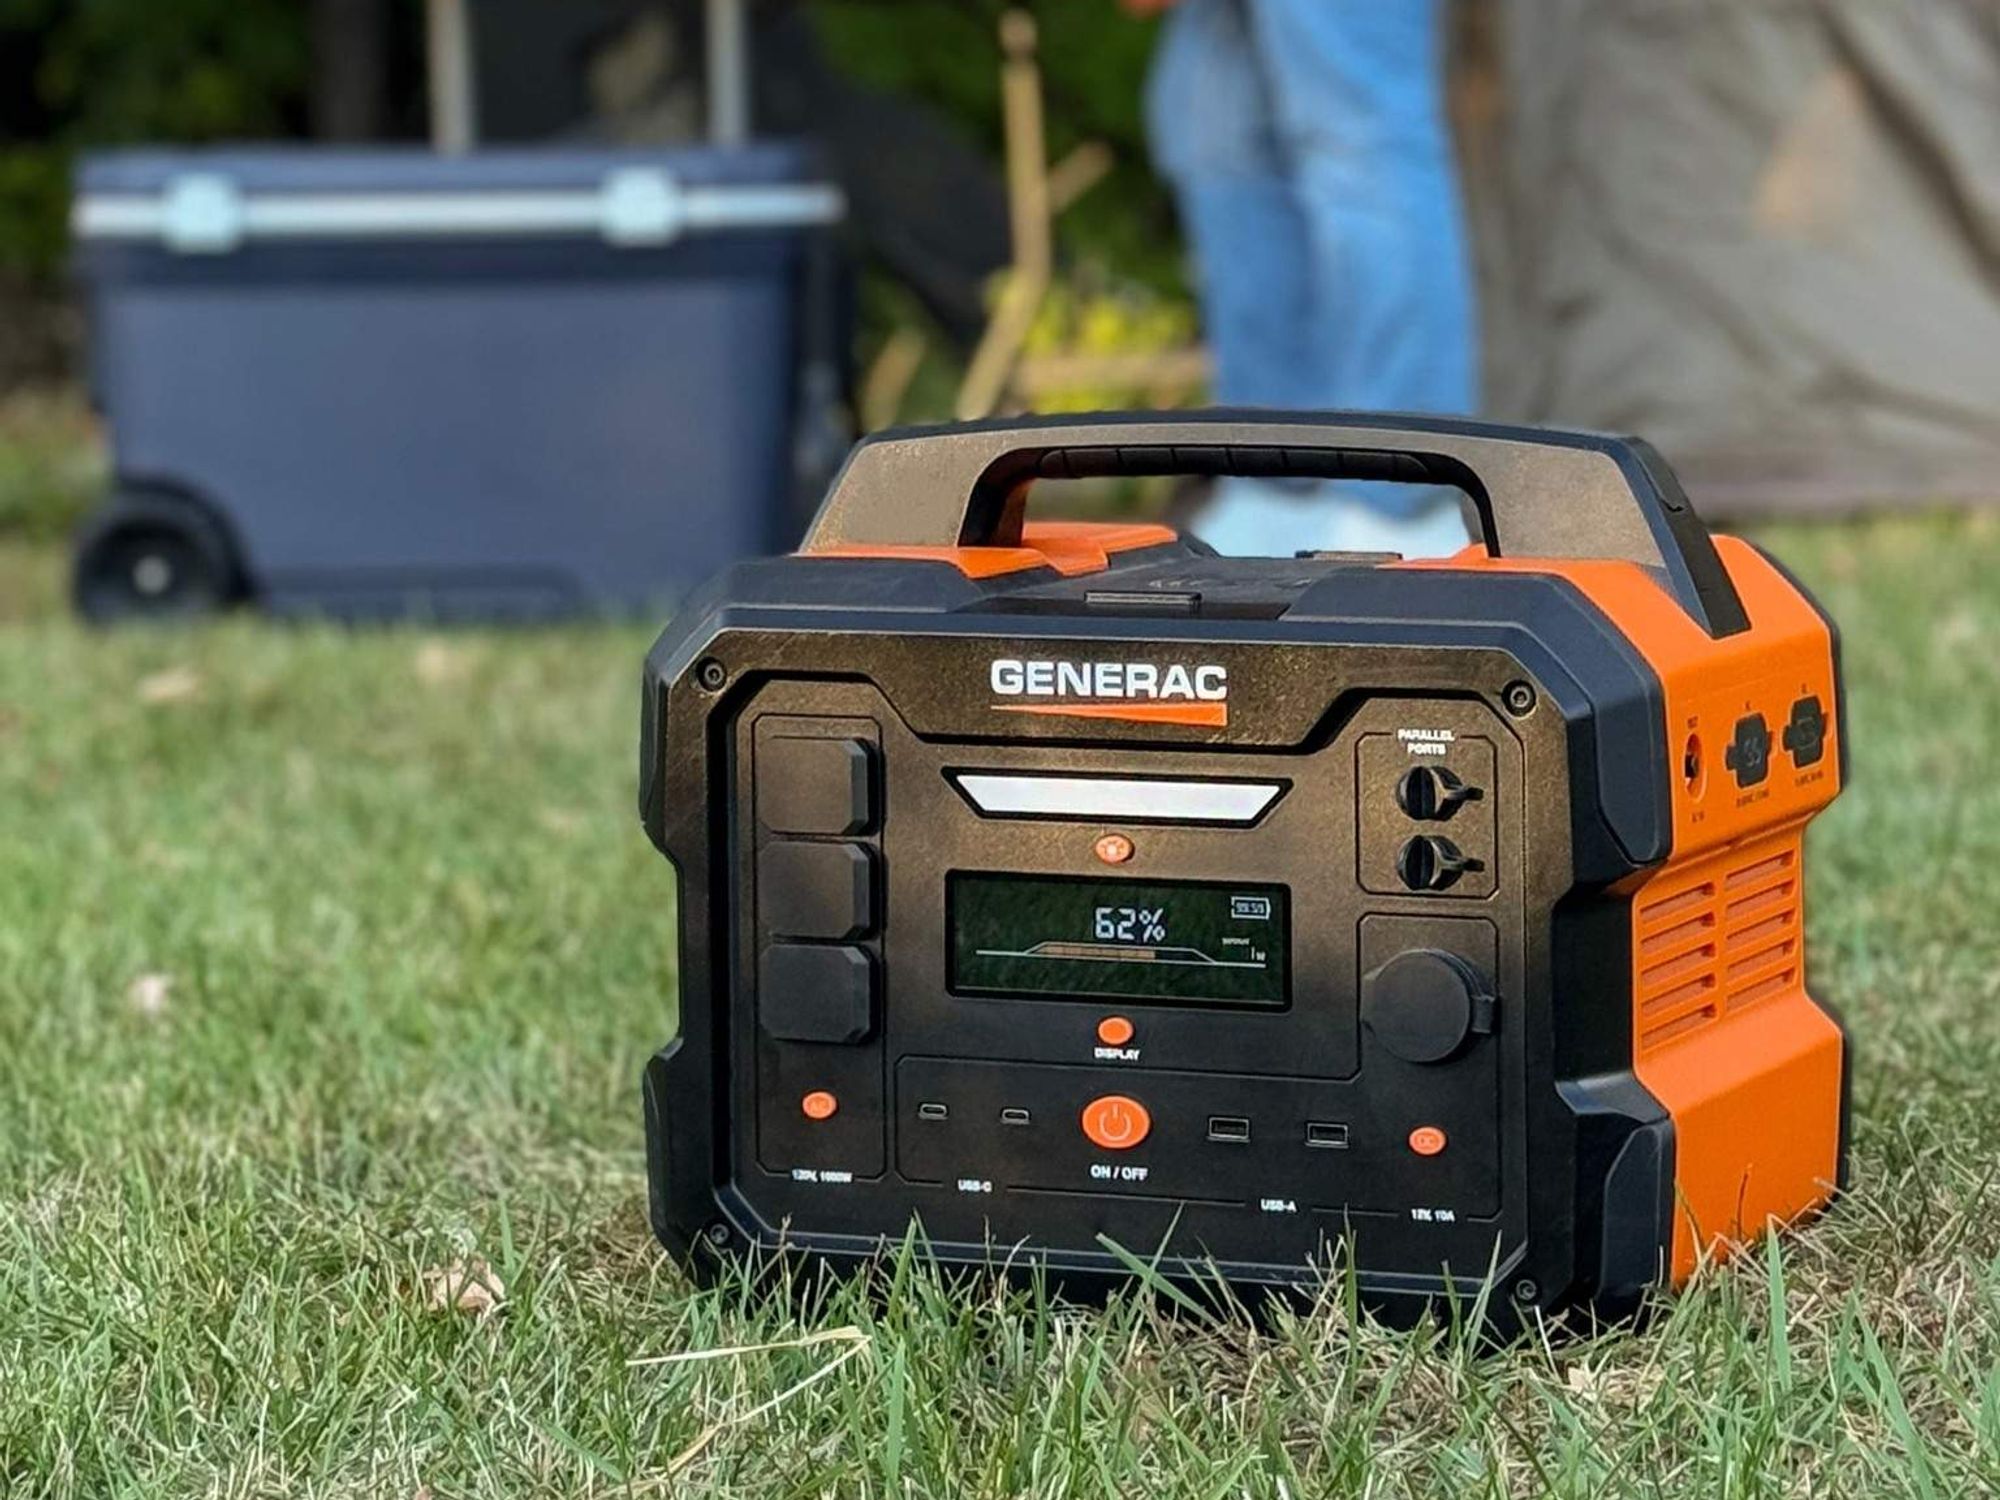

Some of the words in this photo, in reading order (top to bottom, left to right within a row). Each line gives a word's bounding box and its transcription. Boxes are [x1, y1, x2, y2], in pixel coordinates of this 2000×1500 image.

[991, 660, 1228, 700] GENERAC
[1397, 729, 1455, 741] PARALLEL
[1407, 743, 1446, 755] PORTS
[1095, 907, 1166, 941] 62%
[1094, 1047, 1140, 1060] DISPLAY
[1090, 1165, 1111, 1178] ON
[1121, 1168, 1149, 1180] OFF
[957, 1180, 992, 1192] USB-C
[1260, 1199, 1297, 1212] USB-A
